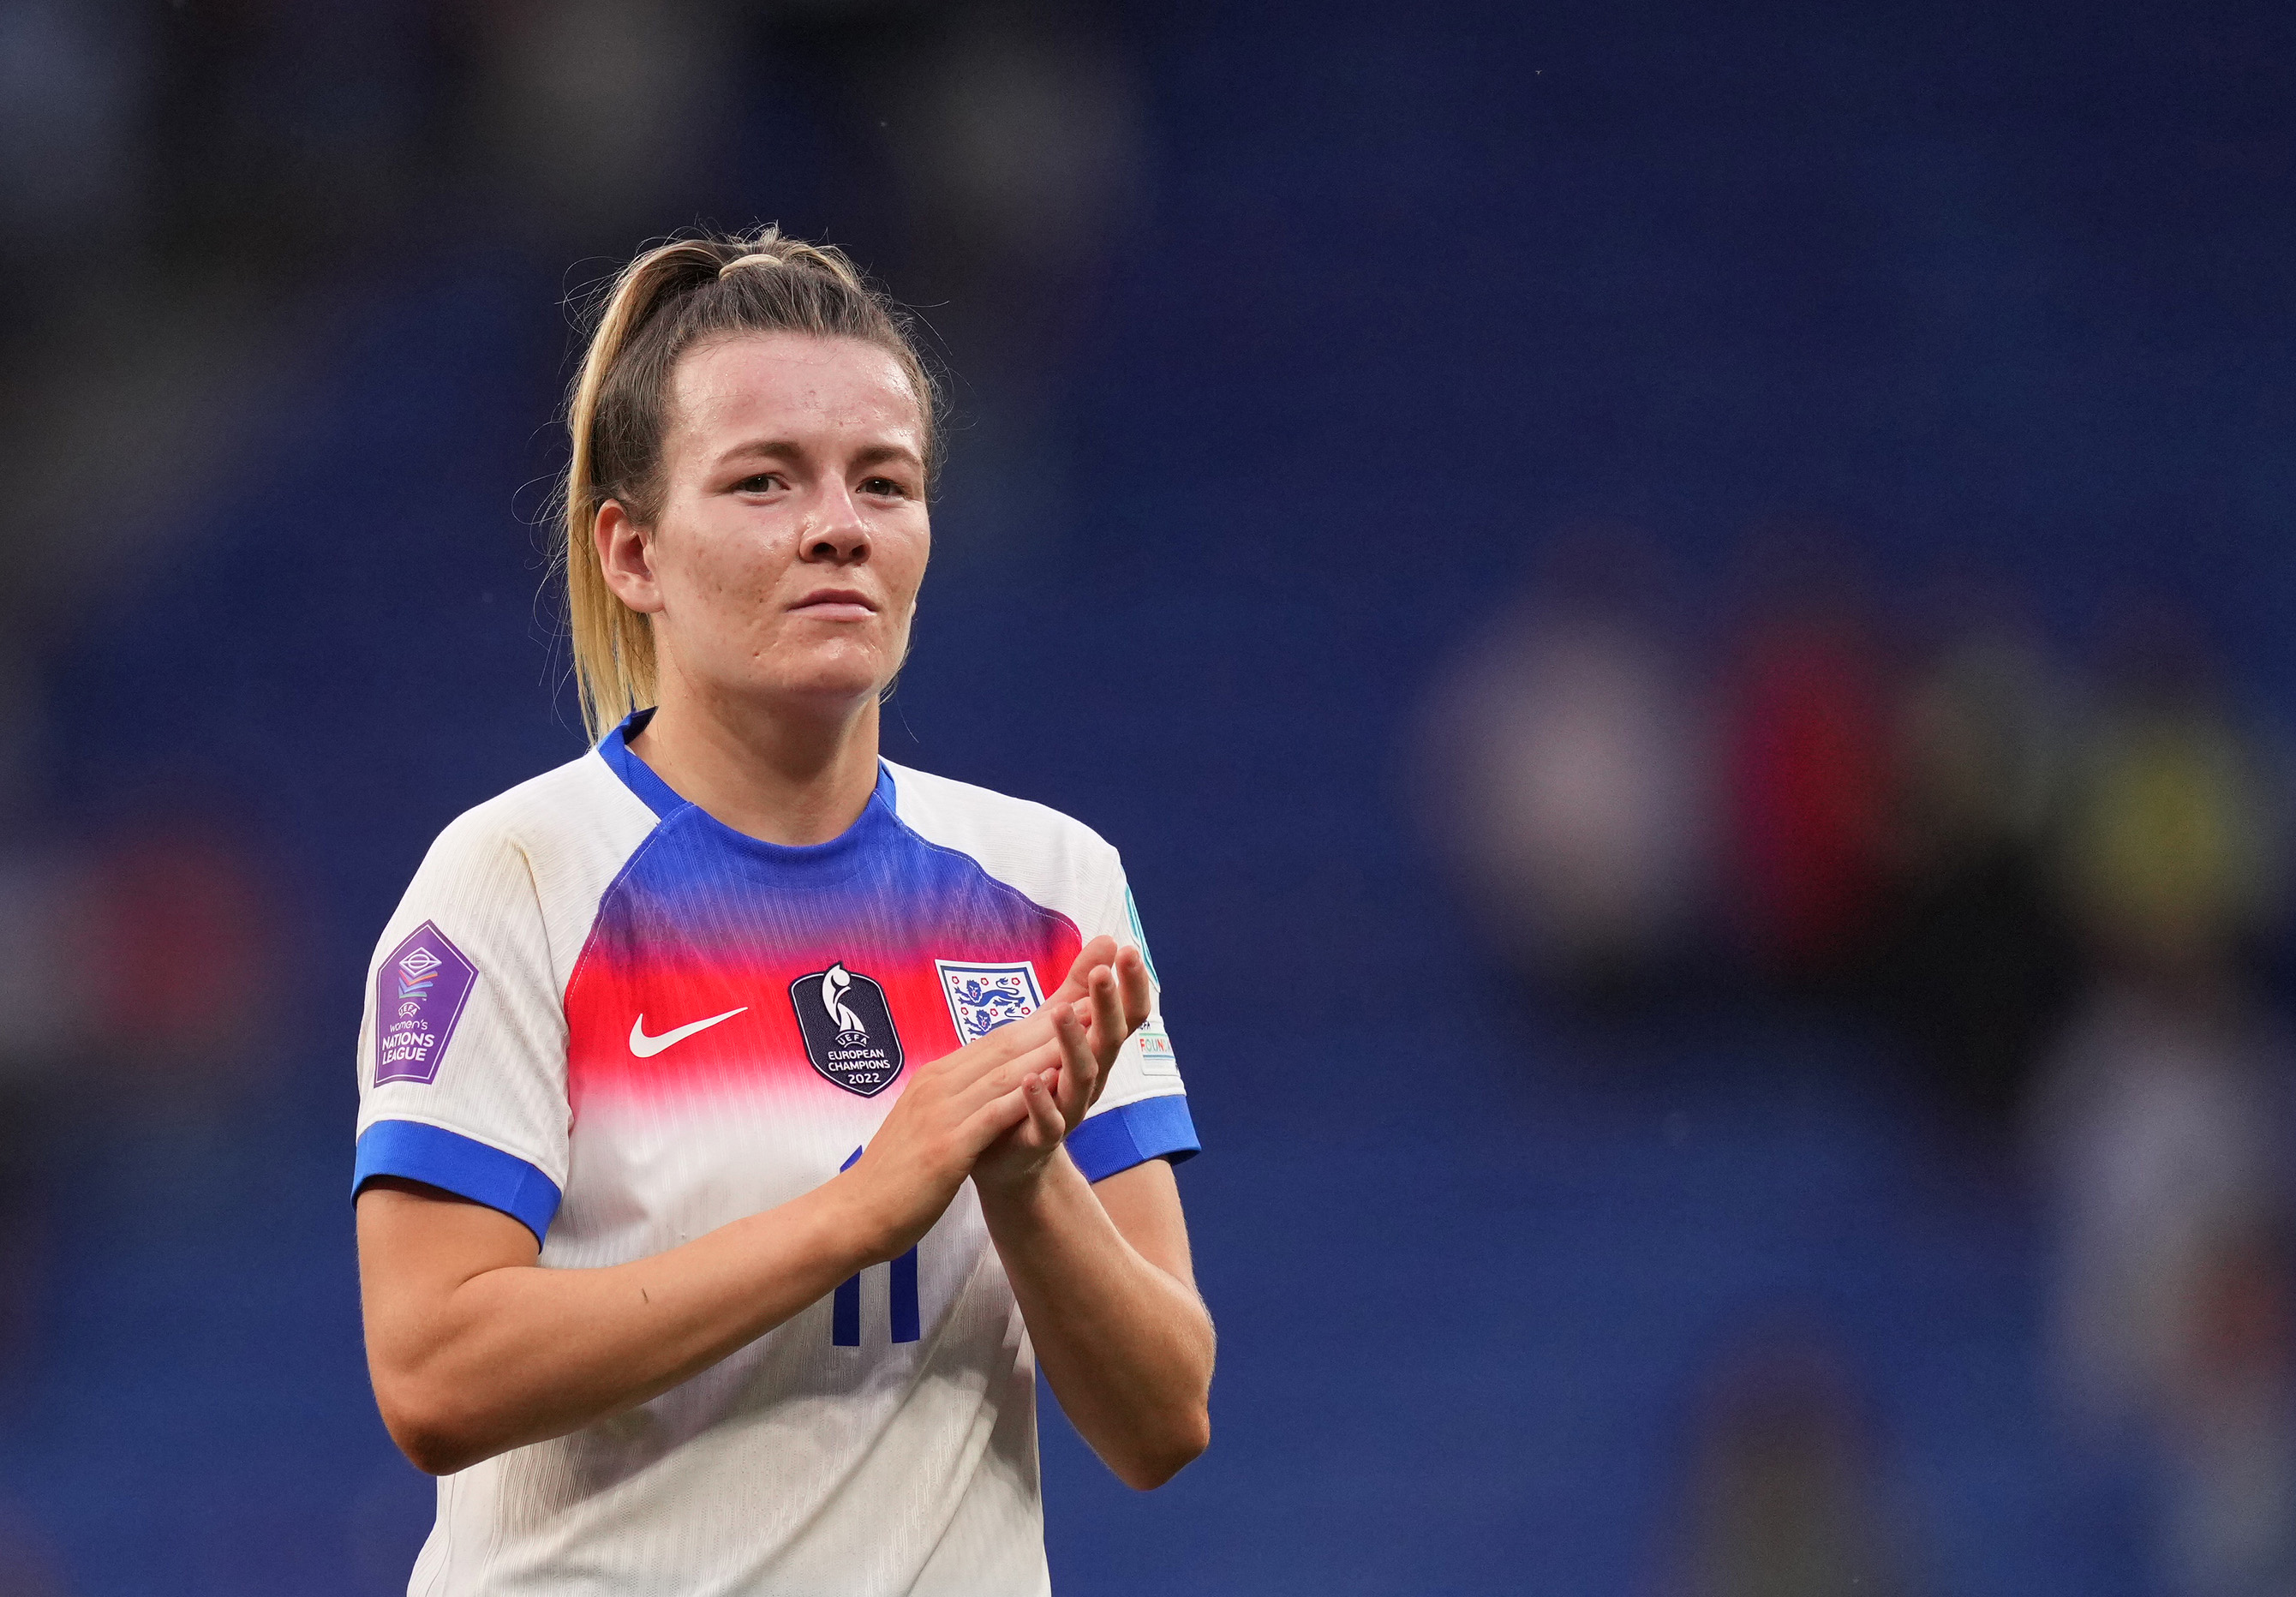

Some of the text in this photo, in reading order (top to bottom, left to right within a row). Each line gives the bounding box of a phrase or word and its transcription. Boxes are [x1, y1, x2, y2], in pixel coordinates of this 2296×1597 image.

[398, 1005, 417, 1016] UEFA
[390, 1019, 428, 1032] women's
[382, 1032, 435, 1050] NATIONS
[838, 1034, 867, 1045] UEFA
[382, 1046, 428, 1065] LEAGUE
[828, 1049, 884, 1060] EUROPEAN
[828, 1059, 891, 1072] CHAMPIONS
[848, 1073, 881, 1084] 2022
